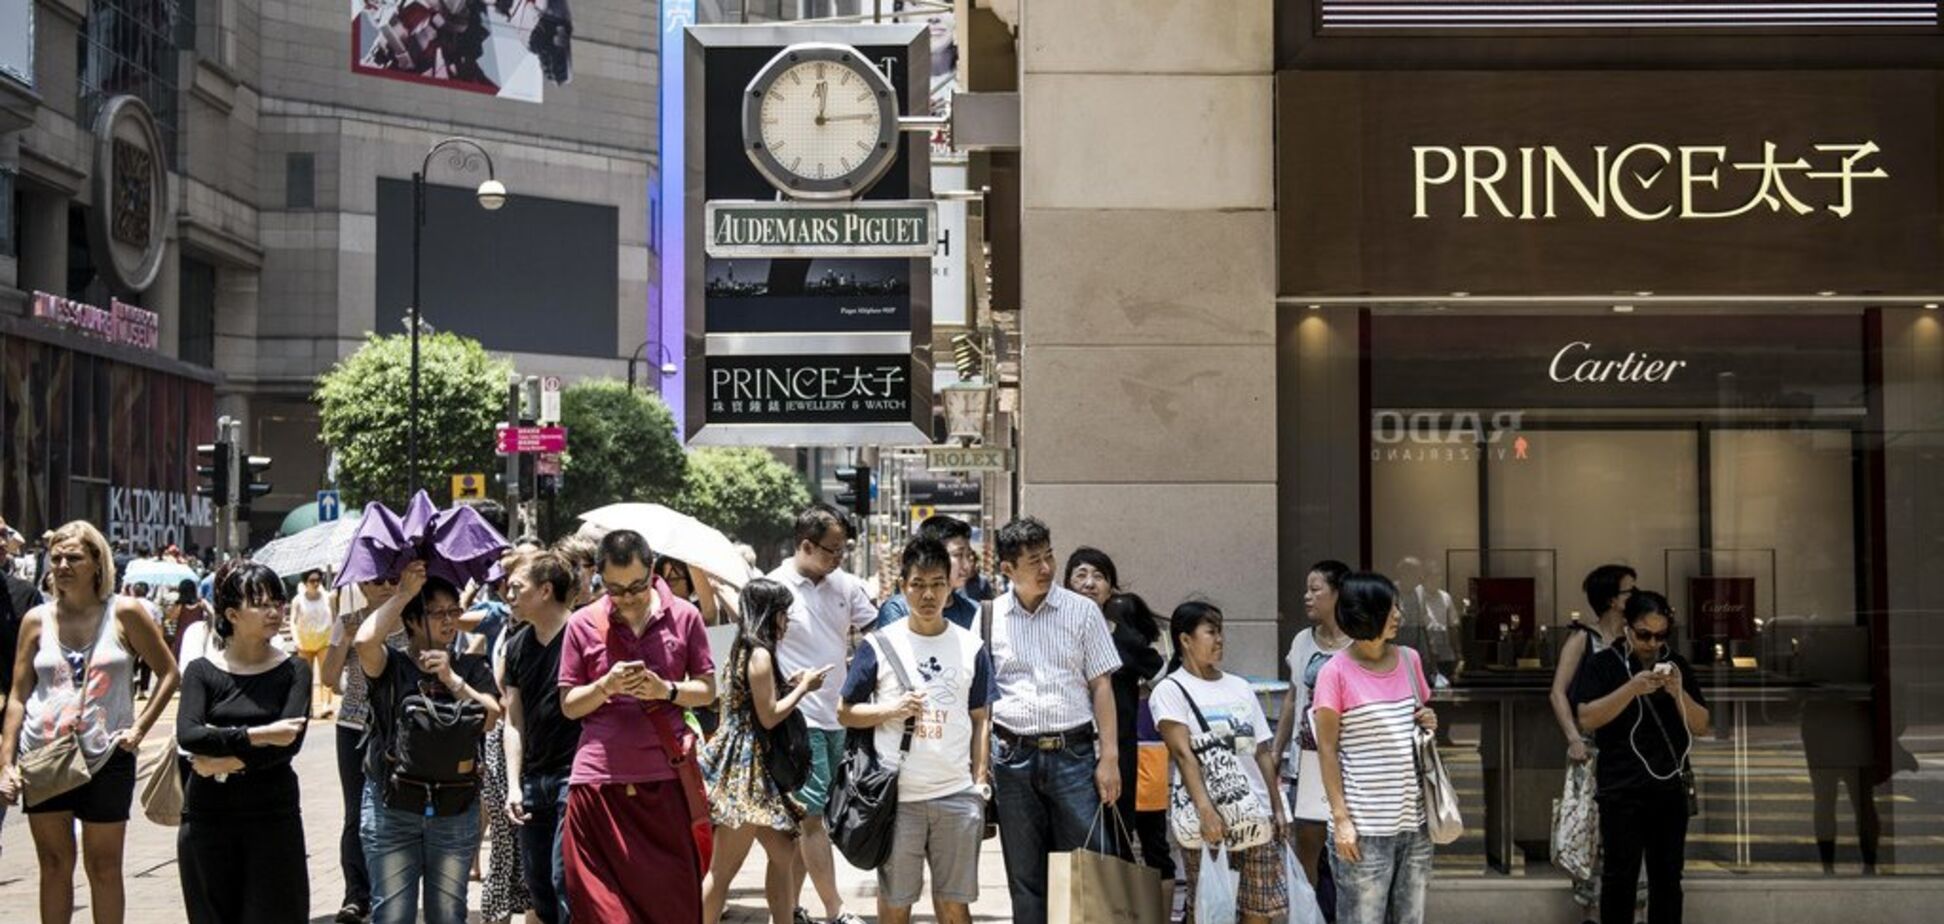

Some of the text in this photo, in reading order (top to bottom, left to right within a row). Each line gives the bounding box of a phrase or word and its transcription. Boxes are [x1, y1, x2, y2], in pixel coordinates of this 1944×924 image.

[1412, 140, 1890, 221] PRINCE 太子
[716, 213, 924, 243] AUDEMARS PIGUET
[1549, 341, 1687, 383] Cartier
[713, 366, 905, 400] PRINCE 太子
[786, 401, 906, 411] JEWELLERY & WATCH
[933, 453, 999, 467] ROLEX
[109, 486, 166, 523] KATOKI
